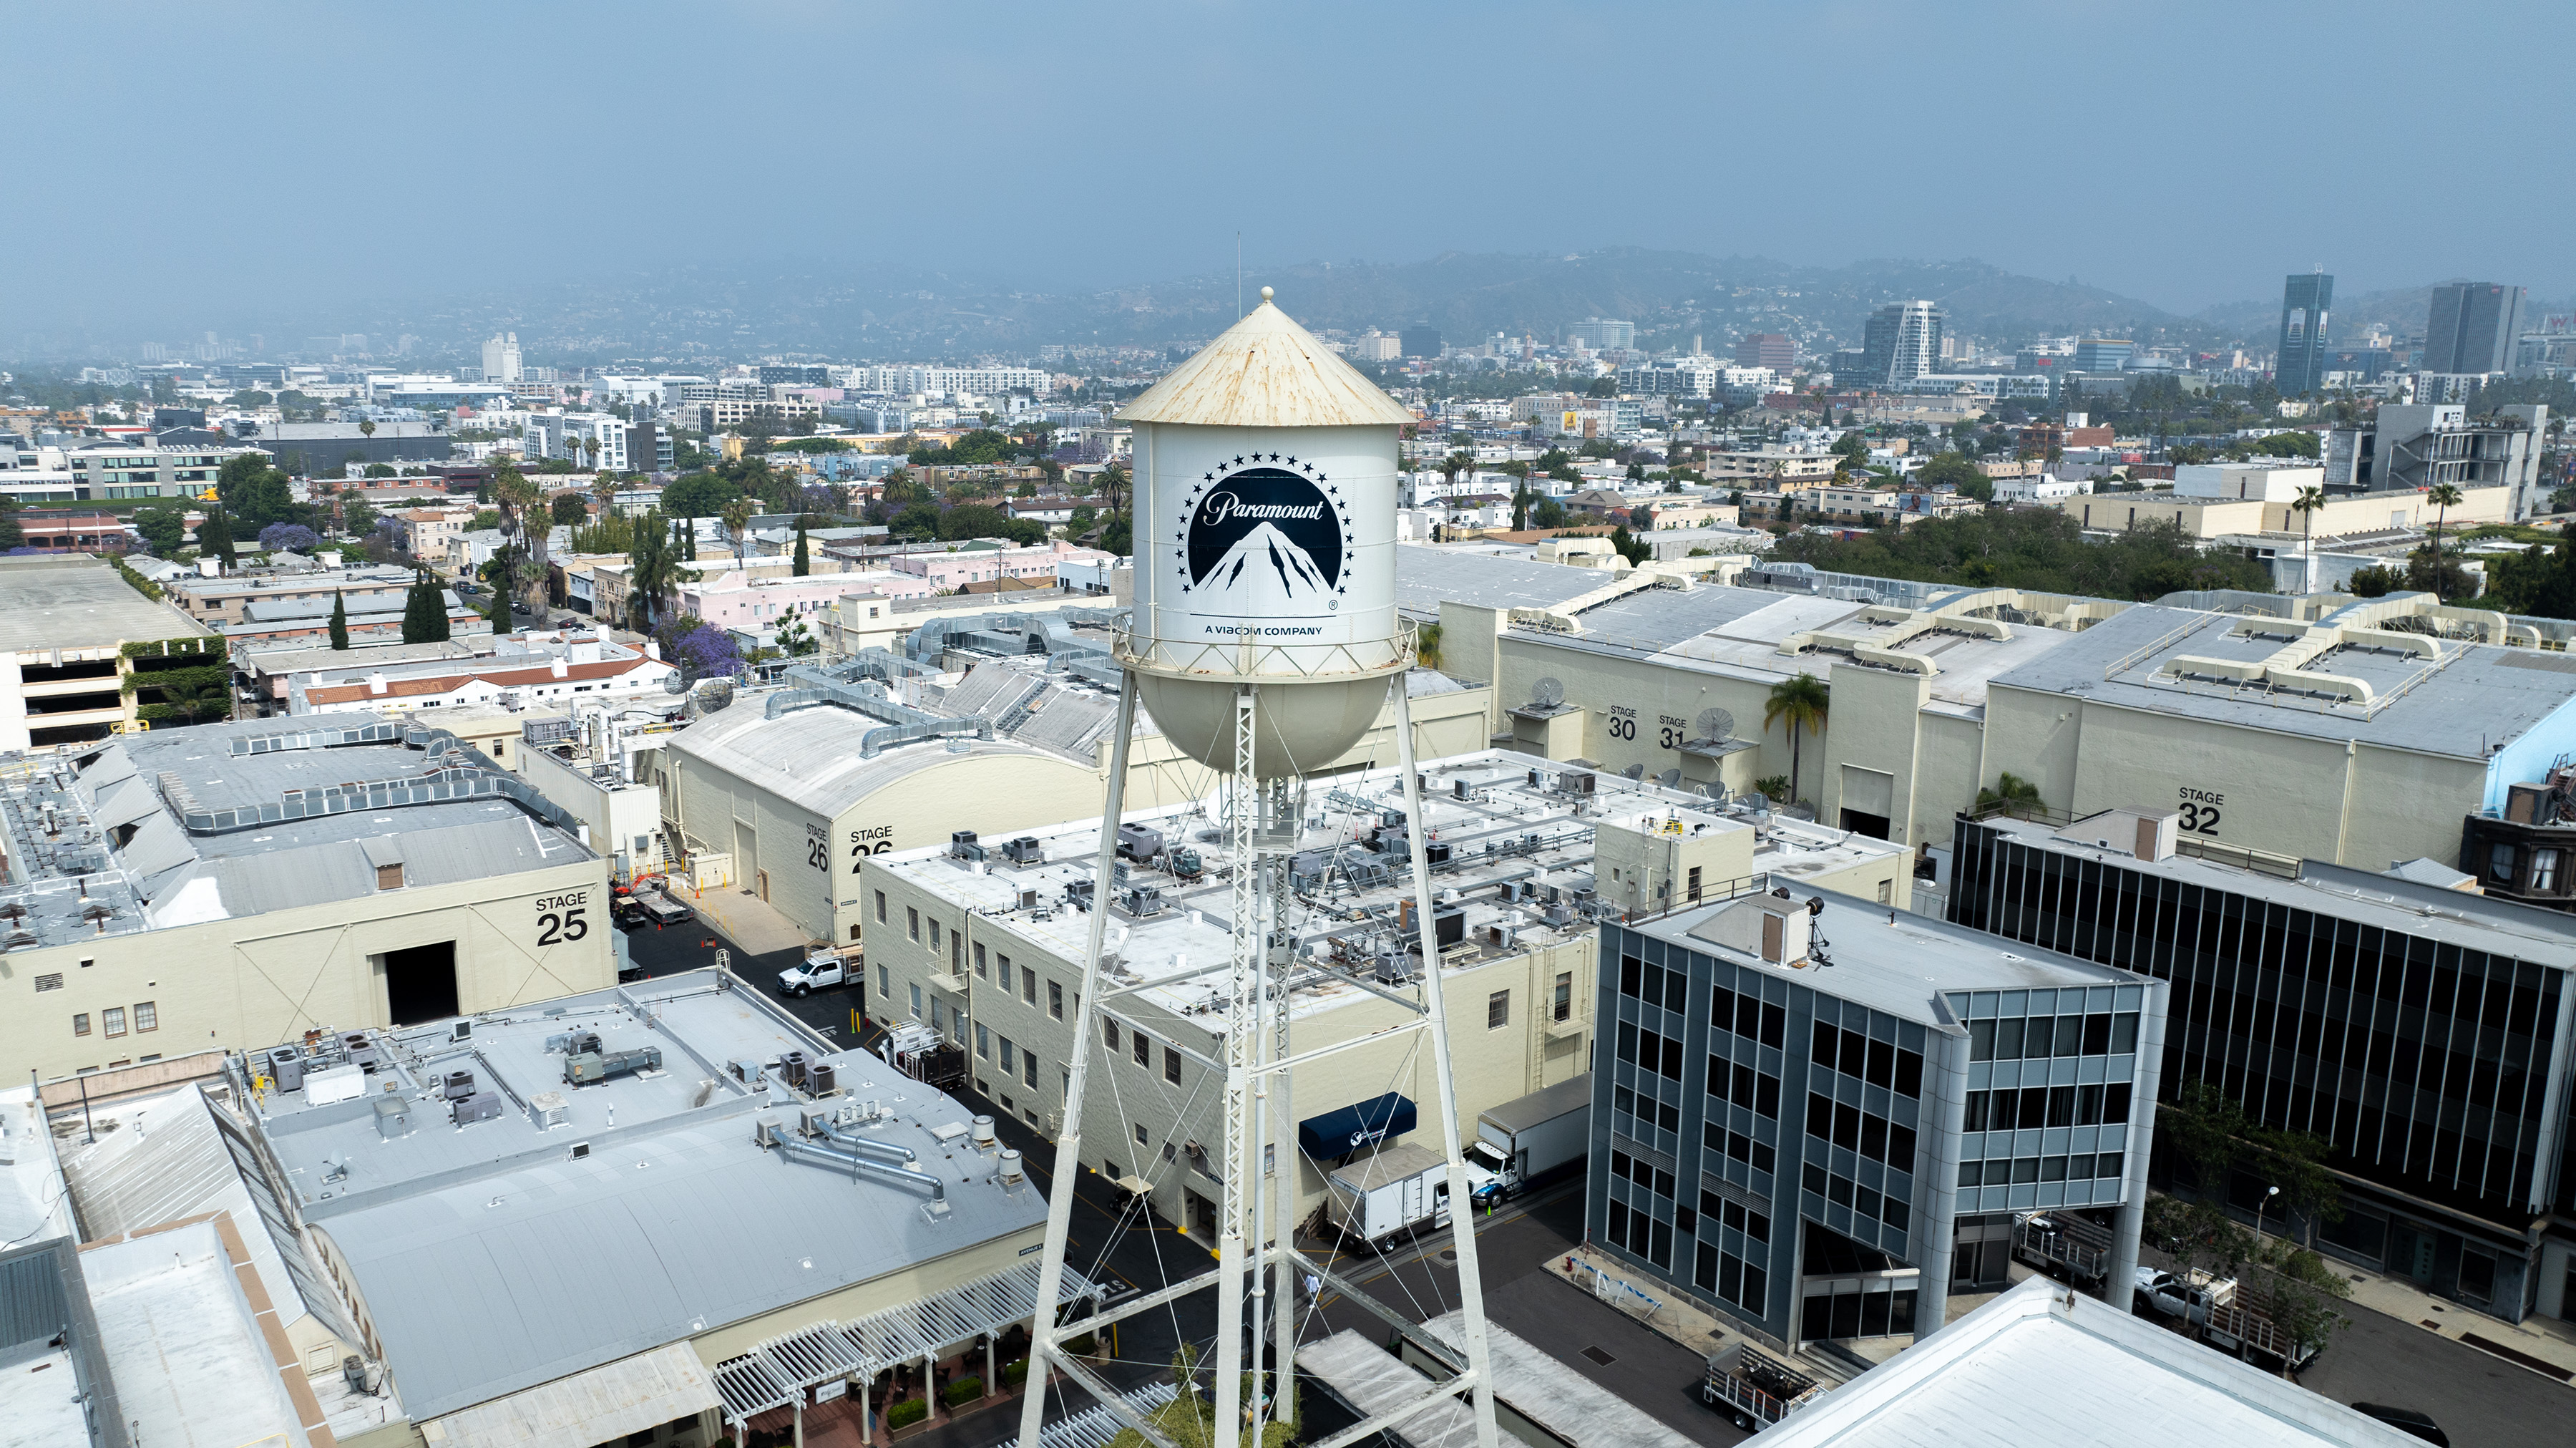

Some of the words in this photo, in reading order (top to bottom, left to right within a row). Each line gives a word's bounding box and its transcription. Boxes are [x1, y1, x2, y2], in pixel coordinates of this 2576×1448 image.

[1203, 491, 1324, 526] Paramount
[1264, 626, 1322, 636] COMPANY
[1611, 705, 1636, 718] STAGE
[1609, 716, 1636, 741] 30
[1659, 715, 1687, 728] STAGE
[1660, 727, 1684, 749] 31
[2179, 787, 2225, 806] STAGE
[2178, 802, 2220, 836] 32
[806, 822, 827, 842] STAGE
[851, 825, 893, 843] STAGE
[808, 838, 829, 873] 26
[536, 892, 587, 911] STAGE
[537, 908, 587, 947] 25
[1020, 1245, 1038, 1255] AVENUE
